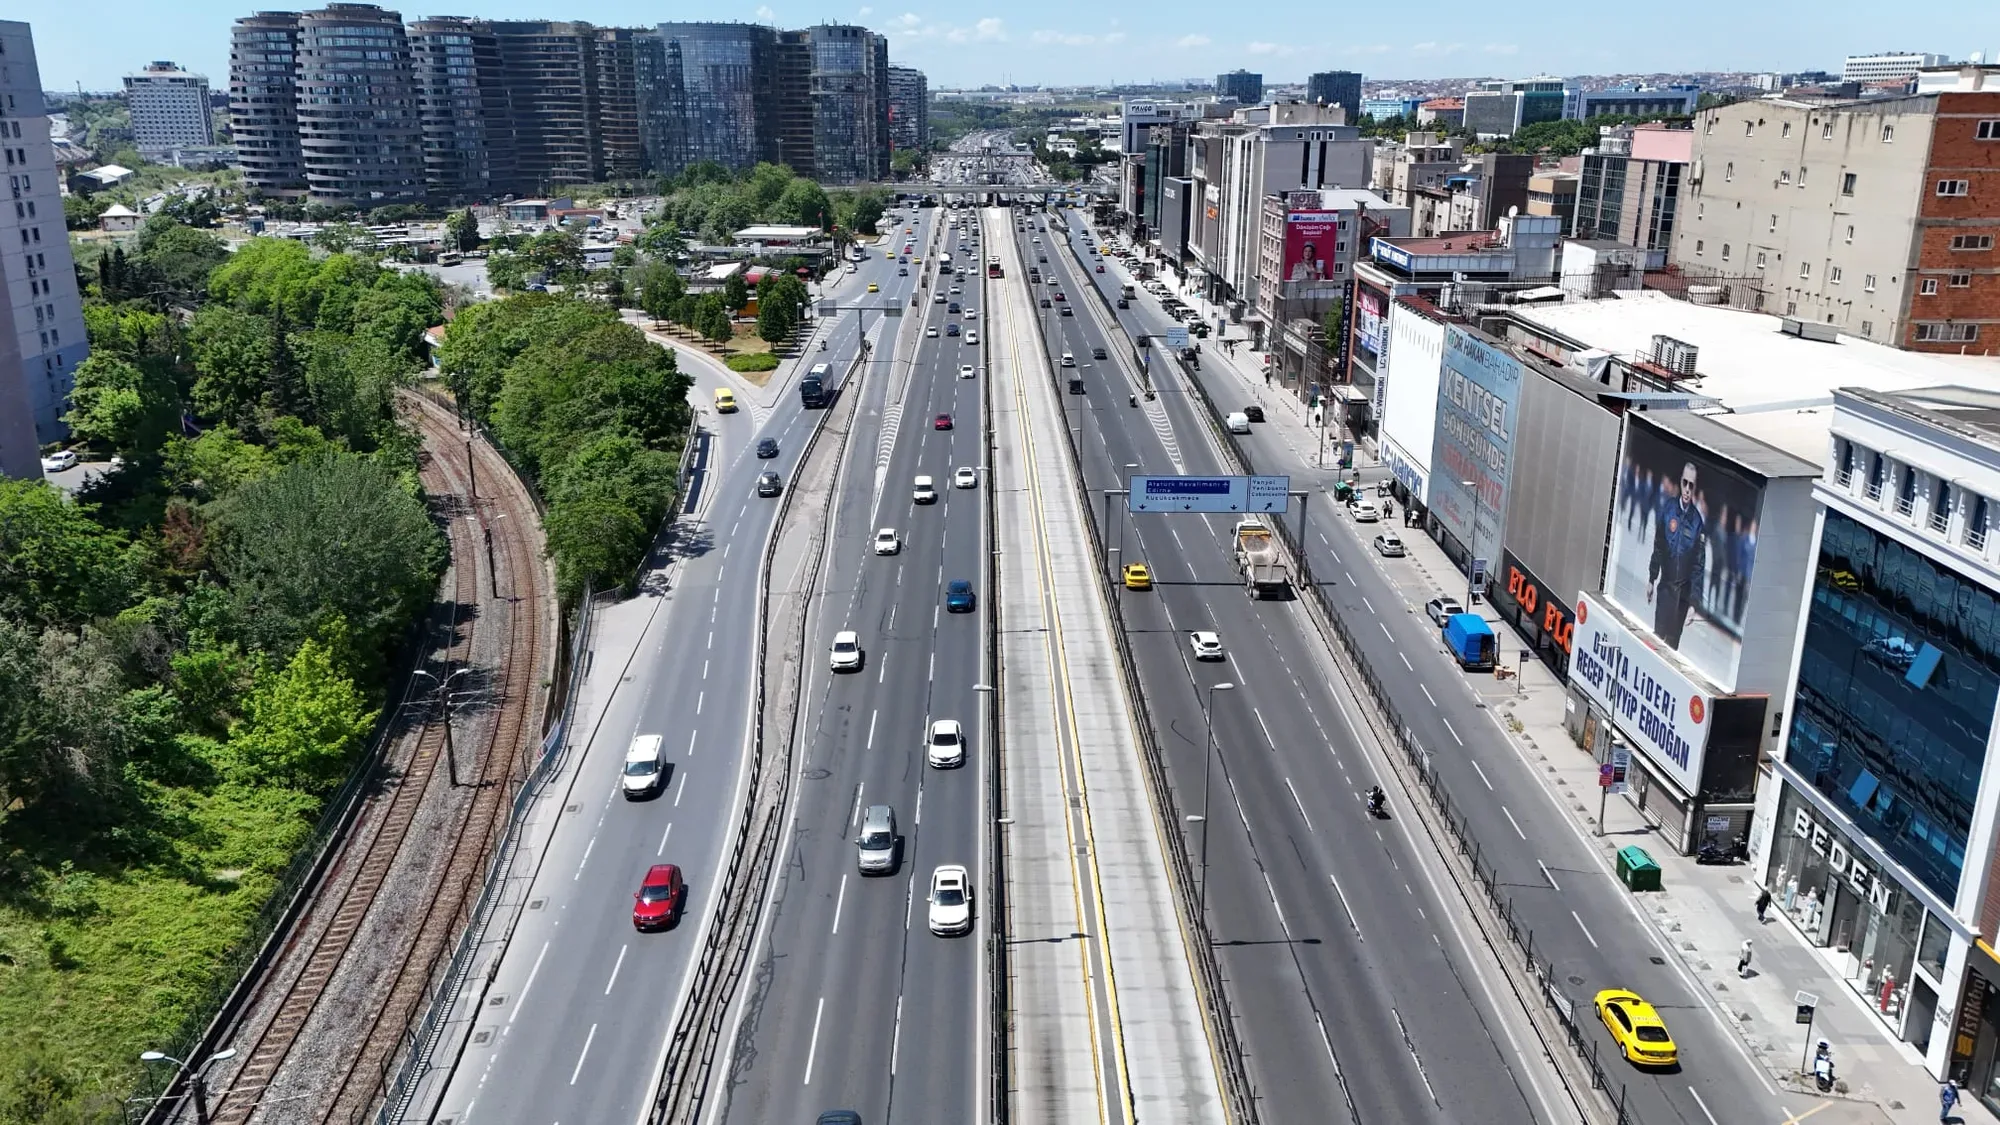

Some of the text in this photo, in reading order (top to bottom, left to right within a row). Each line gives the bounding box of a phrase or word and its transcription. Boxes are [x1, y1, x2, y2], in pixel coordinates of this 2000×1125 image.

[1290, 193, 1321, 204] HOTEL
[1463, 339, 1485, 366] HAKAN
[1443, 366, 1509, 443] KENTSEL
[1508, 565, 1537, 614] FLO
[1544, 601, 1574, 653] FLO
[1593, 631, 1628, 681] DÜNYA
[1576, 647, 1690, 772] RECEP TAYYİP ERDOĞAN
[1794, 807, 1892, 916] BEDEN
[1960, 972, 1986, 1035] istikbal
